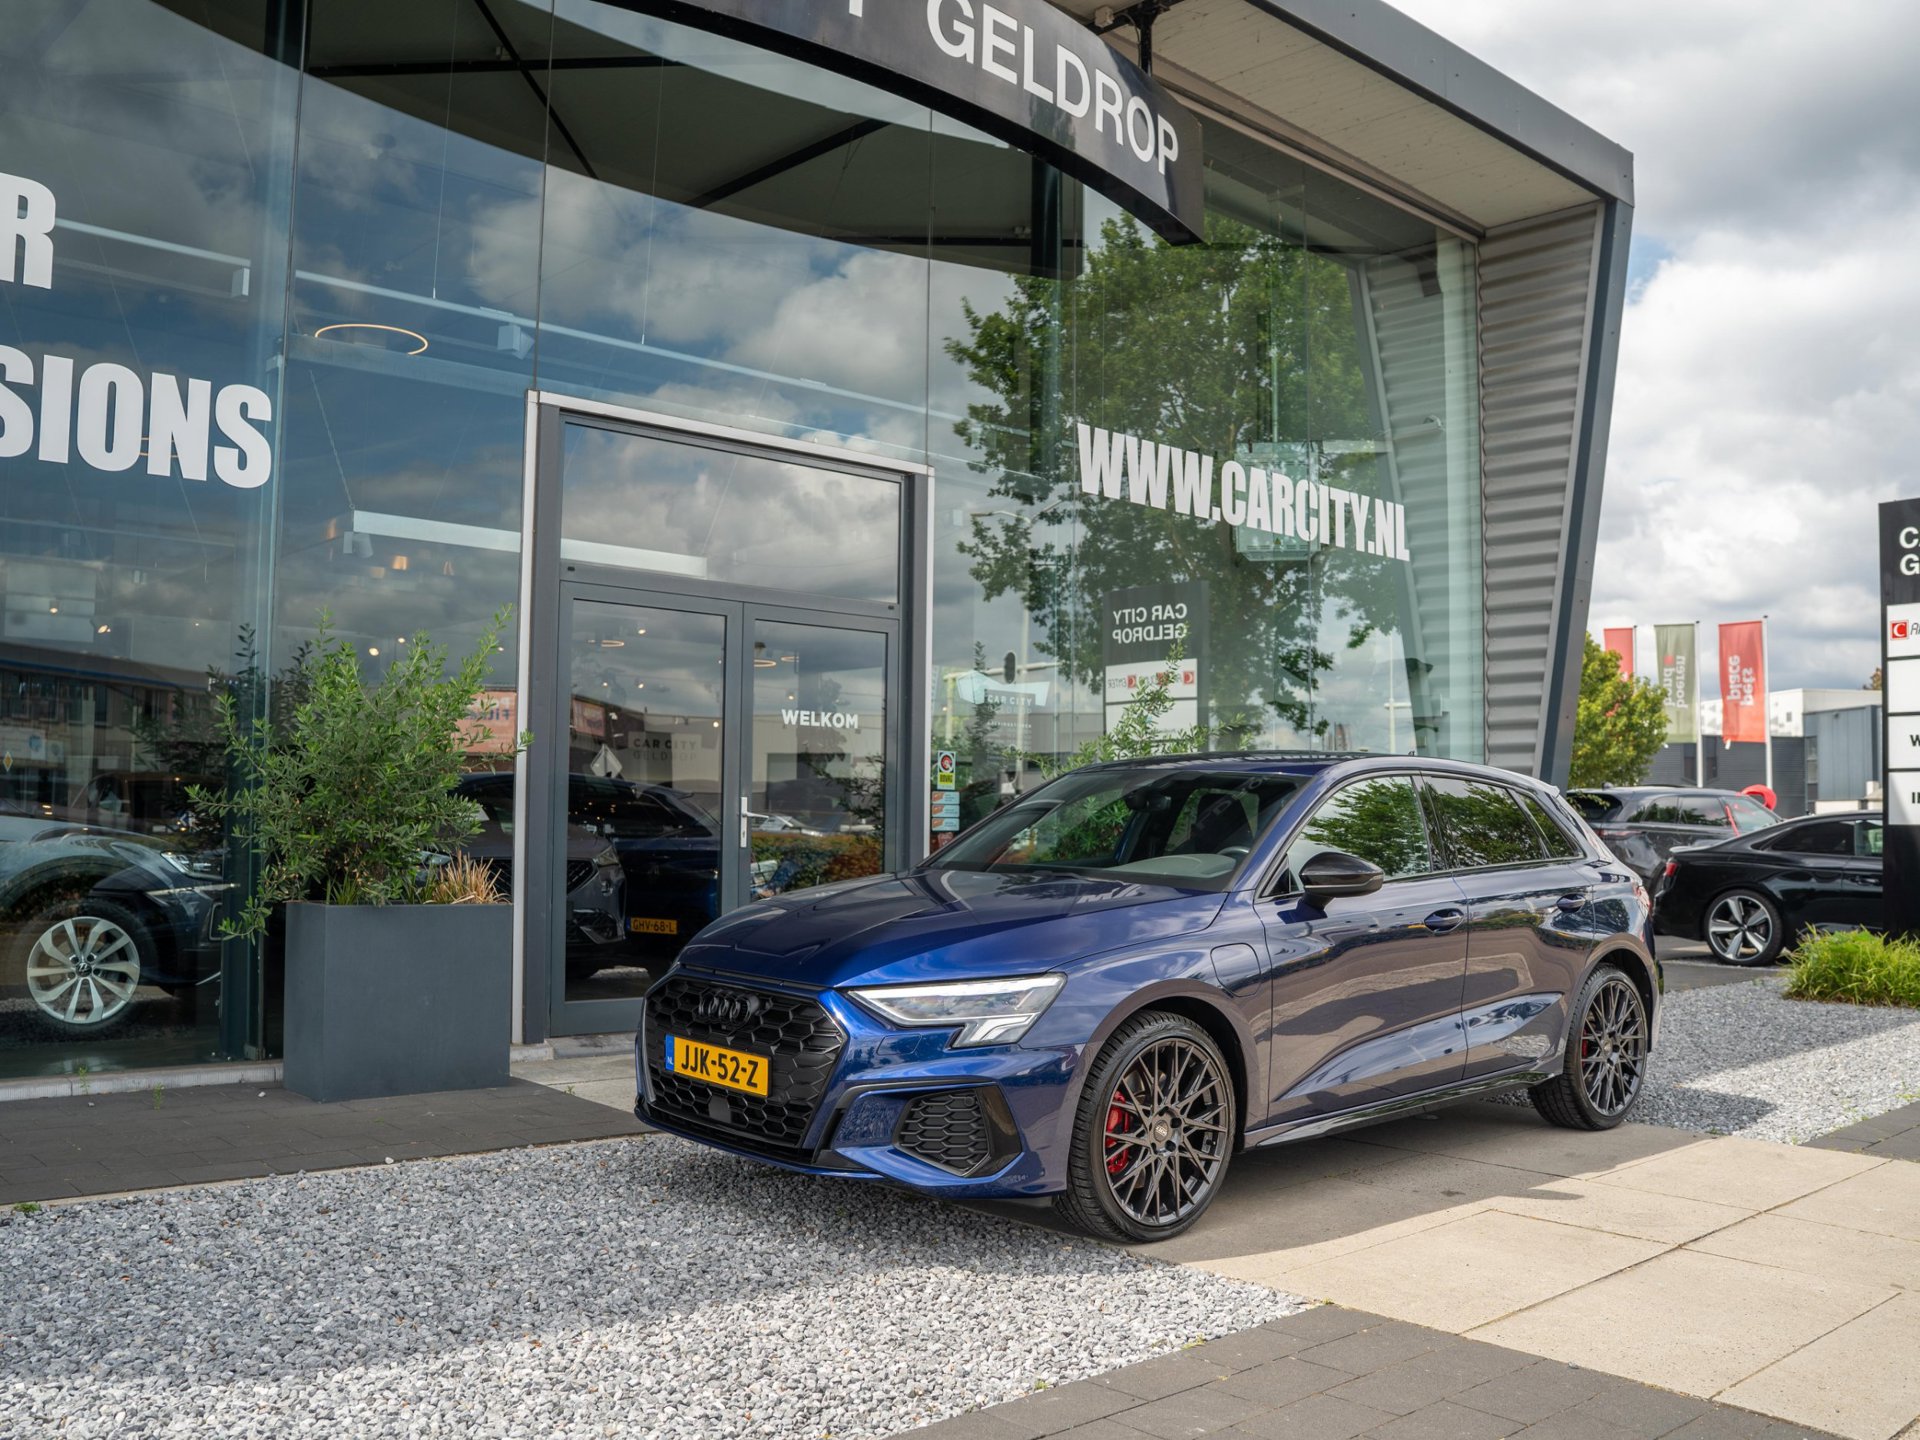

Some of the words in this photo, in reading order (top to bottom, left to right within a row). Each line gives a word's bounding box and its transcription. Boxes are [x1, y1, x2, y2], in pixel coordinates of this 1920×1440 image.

[926, 0, 1180, 176] GELDROP
[1077, 423, 1410, 562] WWW.CARCITY.NL
[781, 708, 859, 729] WELKOM
[633, 738, 660, 749] CAR
[665, 739, 696, 750] CITY
[632, 919, 675, 933] GHV-68-L
[667, 1056, 674, 1065] NL
[681, 1044, 759, 1088] JJK-52-Z
